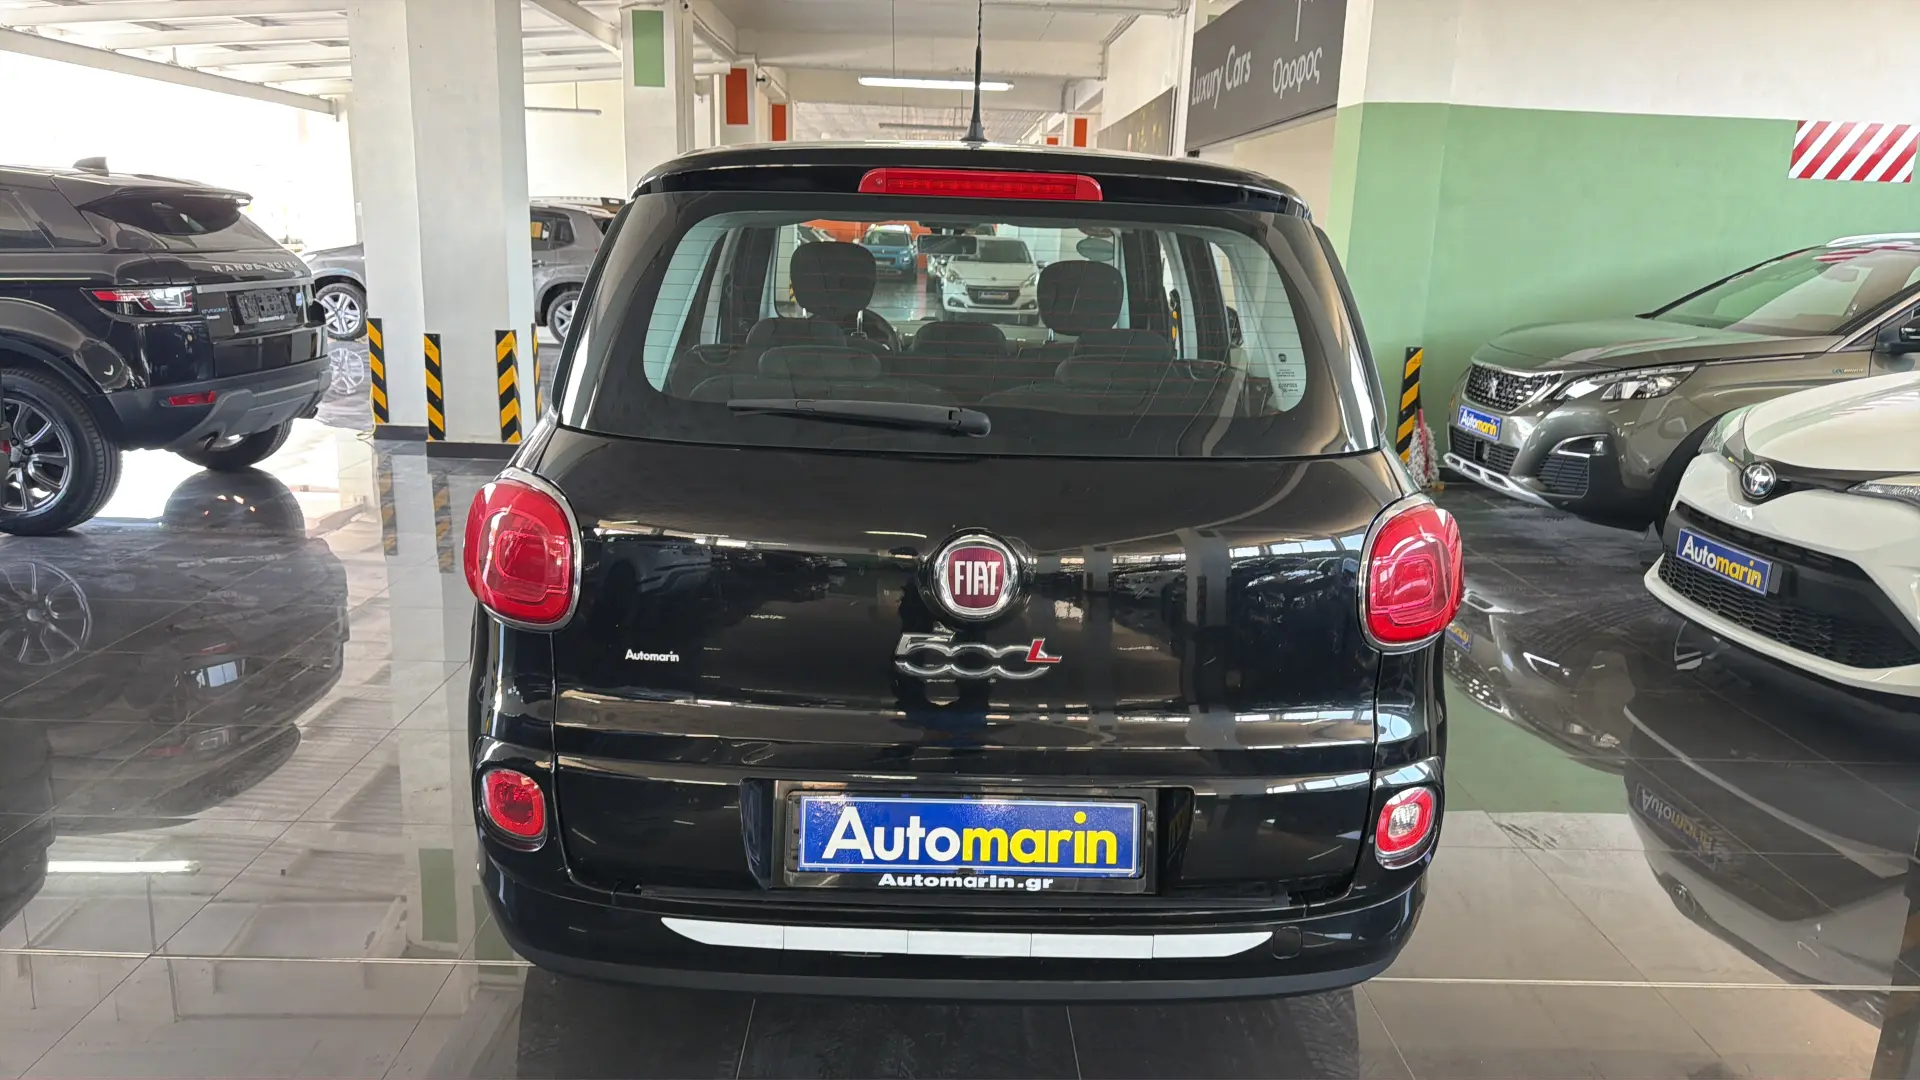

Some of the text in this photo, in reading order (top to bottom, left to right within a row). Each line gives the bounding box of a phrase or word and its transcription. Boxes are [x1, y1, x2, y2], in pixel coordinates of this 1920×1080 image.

[1191, 44, 1252, 110] Luxury Cars
[1460, 408, 1498, 437] Automarin
[954, 560, 1001, 596] FIAT
[1681, 534, 1763, 589] Automarin
[624, 648, 680, 662] Automarin
[894, 631, 1063, 680] 500L
[821, 805, 1117, 865] Automarin
[877, 872, 1054, 892] Automarin.gr
